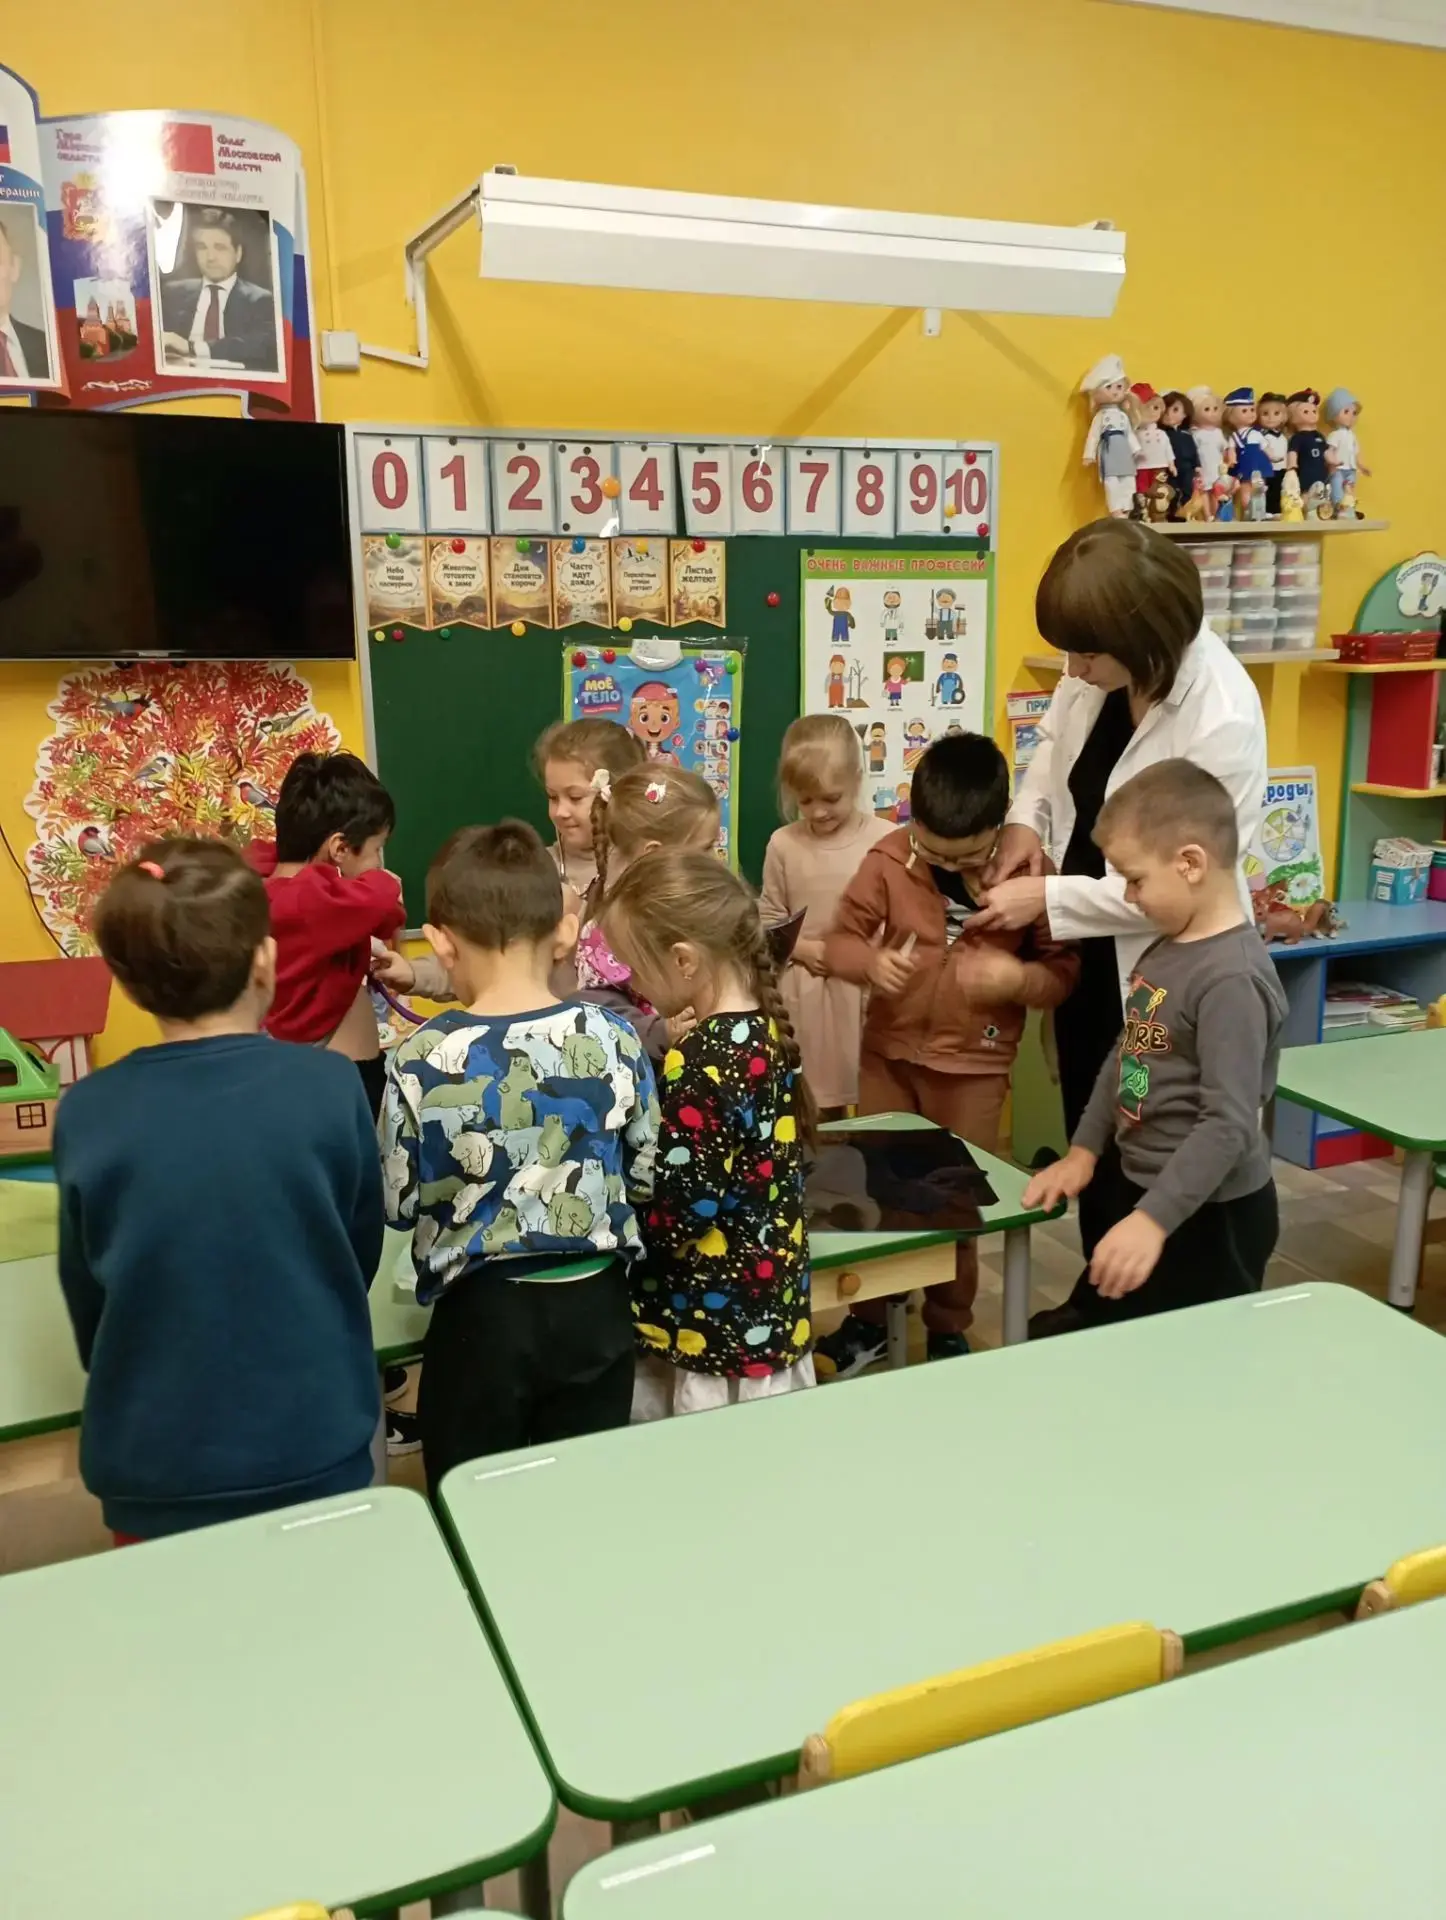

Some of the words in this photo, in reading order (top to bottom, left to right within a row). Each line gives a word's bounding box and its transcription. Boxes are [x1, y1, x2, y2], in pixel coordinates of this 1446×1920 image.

[372, 452, 408, 509] 0
[440, 455, 467, 511] 1
[506, 455, 542, 510] 2
[570, 456, 603, 514] 3
[629, 457, 664, 511] 4
[692, 461, 721, 514] 5
[742, 460, 773, 512] 6
[800, 462, 829, 513] 7
[856, 464, 884, 516] 8
[909, 464, 937, 514] 9
[945, 468, 988, 514] 10
[386, 566, 405, 574] Небо
[513, 563, 529, 572] Дни
[570, 562, 593, 570] Часто
[572, 571, 591, 580] идут
[685, 565, 713, 574] Листья
[807, 559, 846, 571] ОЧЕНЬ
[853, 559, 905, 571] ВАЖНЫЕ
[911, 559, 986, 573] ПРОФЕССИИ
[581, 690, 620, 704] ТЕЛО
[1026, 699, 1052, 712] ПРИ
[1265, 784, 1309, 802] роды
